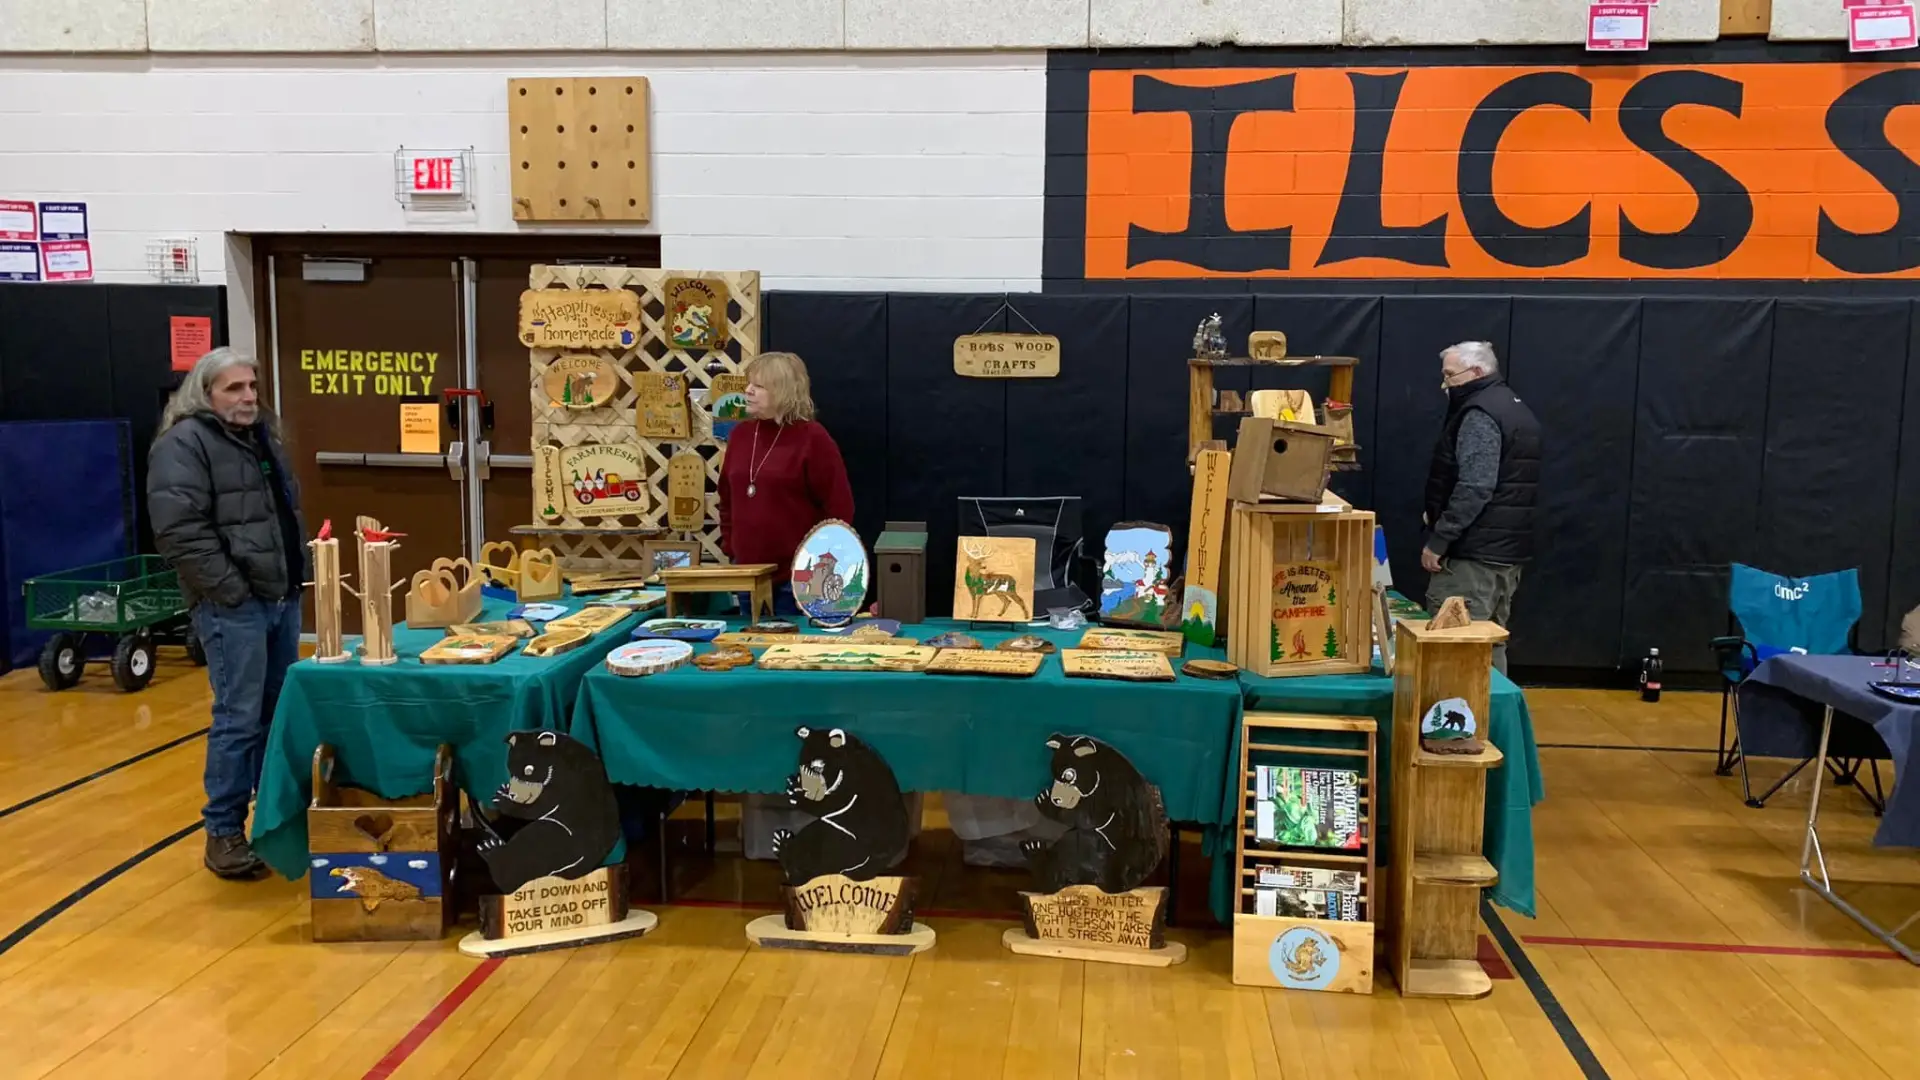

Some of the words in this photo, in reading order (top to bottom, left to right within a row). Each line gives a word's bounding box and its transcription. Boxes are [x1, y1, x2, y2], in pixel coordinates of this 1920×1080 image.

[413, 158, 453, 190] EXIT
[670, 280, 716, 300] WELCOME
[578, 315, 588, 328] is
[543, 323, 615, 341] homemade
[1014, 342, 1053, 353] WOOD
[301, 349, 438, 373] EMERGENCY
[552, 359, 603, 373] WELCOME
[984, 360, 1037, 370] CRAFTS
[310, 373, 366, 395] EXIT
[374, 374, 433, 396] ONLY
[566, 447, 597, 468] FARM
[599, 446, 637, 463] FRESH
[542, 446, 554, 503] WELCOME
[1197, 453, 1218, 587] WELCOME
[1288, 567, 1297, 577] IS
[1298, 565, 1331, 584] BETTER
[1280, 581, 1319, 597] Around
[1273, 605, 1327, 620] CAMPFIRE
[1333, 771, 1346, 808] EARTH
[1345, 785, 1358, 834] MOTHER
[1333, 813, 1347, 847] NEWS
[514, 890, 535, 902] SIT
[540, 885, 580, 899] DOWN
[583, 881, 608, 893] AND
[795, 884, 898, 913] WELCOME
[1096, 896, 1144, 907] MATTER
[507, 907, 541, 921] TAKE
[543, 902, 578, 916] LOAD
[581, 898, 607, 911] OFF
[1033, 902, 1055, 914] ONE
[1058, 906, 1083, 918] HUG
[1084, 908, 1115, 920] FROM
[1116, 910, 1142, 922] THE
[507, 919, 543, 934] YOUR
[550, 914, 583, 928] MIND
[1035, 914, 1066, 926] RIGHT
[1069, 917, 1116, 931] PERSON
[1119, 921, 1152, 936] TAKES
[1042, 928, 1065, 939] ALL
[1067, 929, 1114, 944] STRESS
[1117, 935, 1150, 947] AWAY
